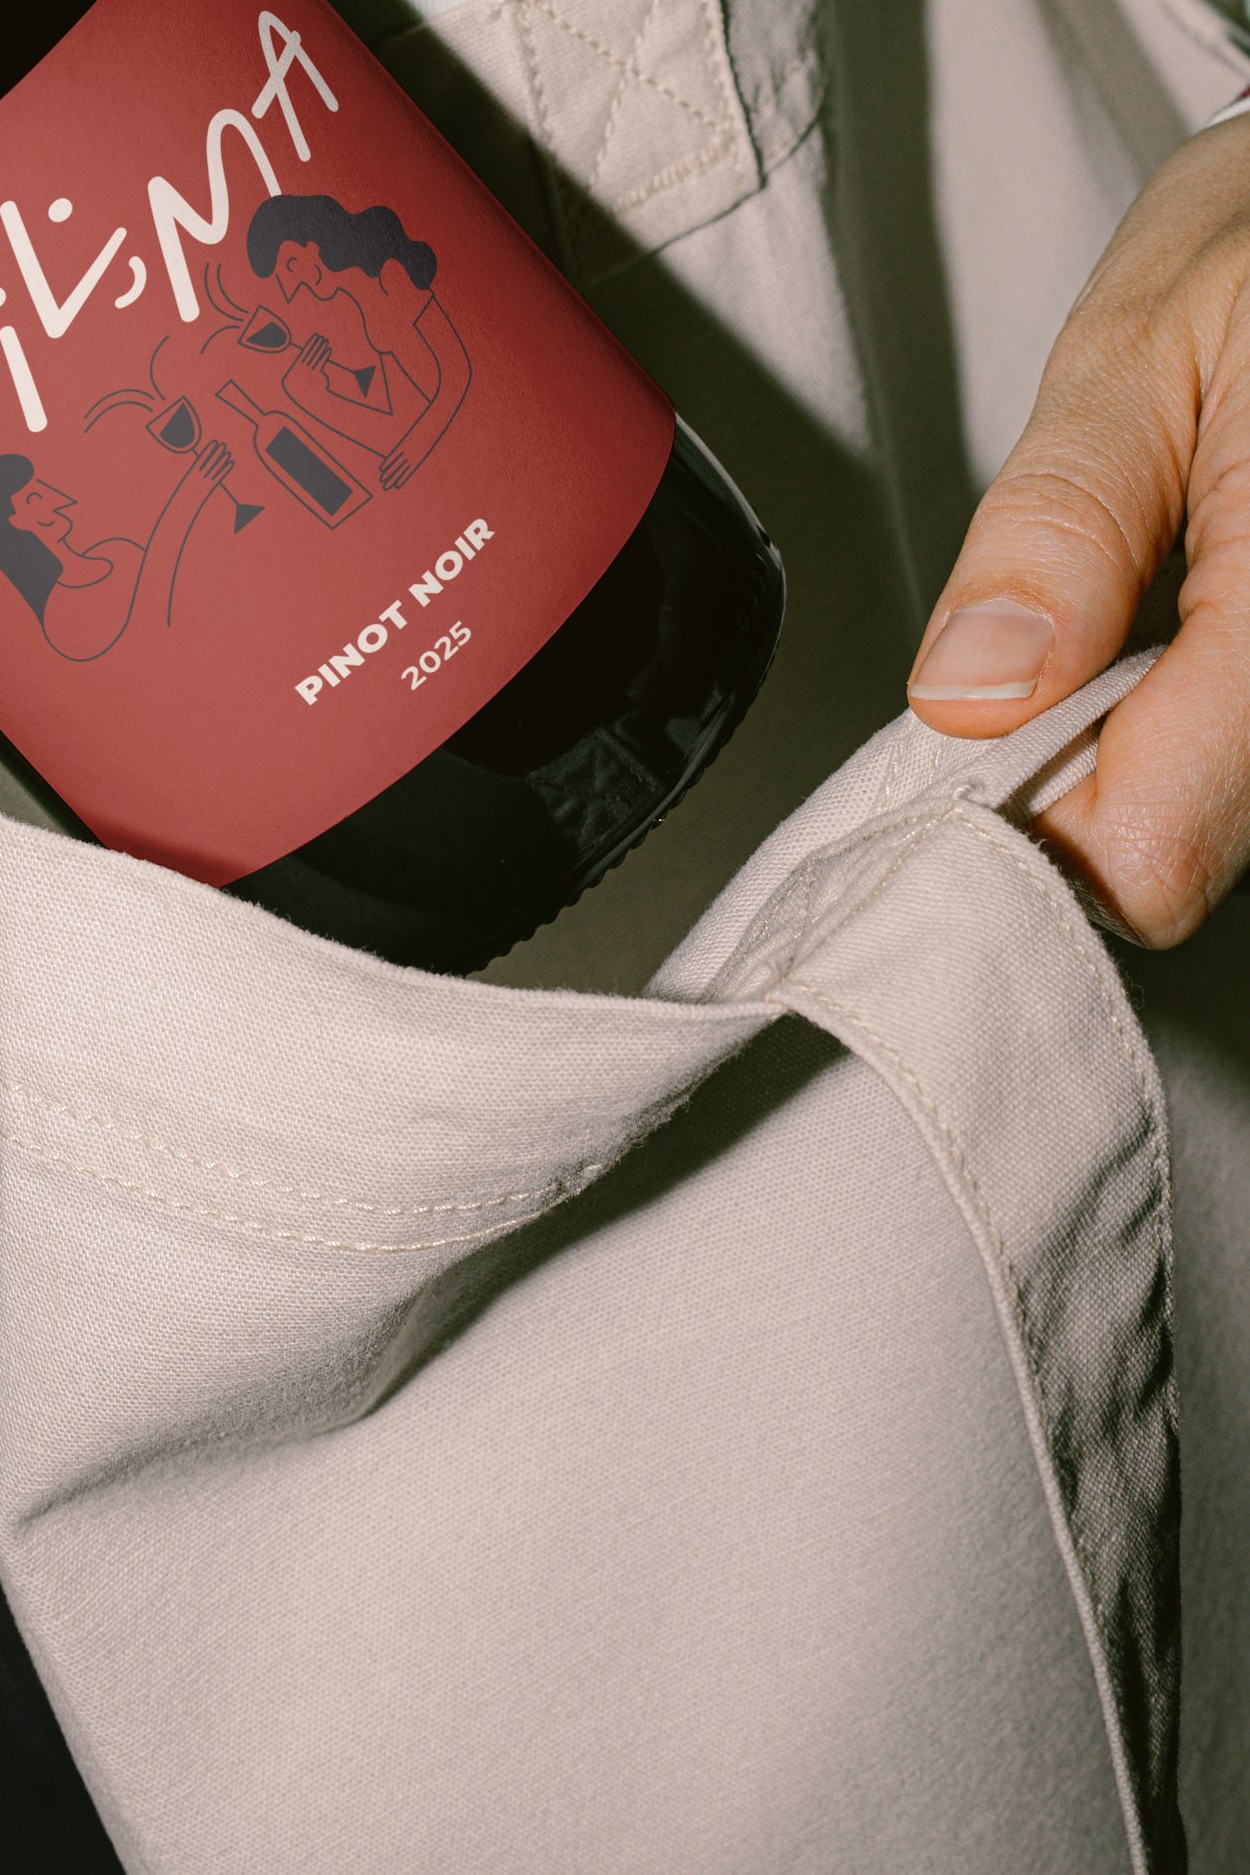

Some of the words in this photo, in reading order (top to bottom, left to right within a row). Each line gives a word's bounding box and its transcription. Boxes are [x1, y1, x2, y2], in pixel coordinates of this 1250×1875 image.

[294, 599, 409, 706] PINOT
[408, 518, 496, 608] NOIR
[400, 620, 472, 691] 2025
